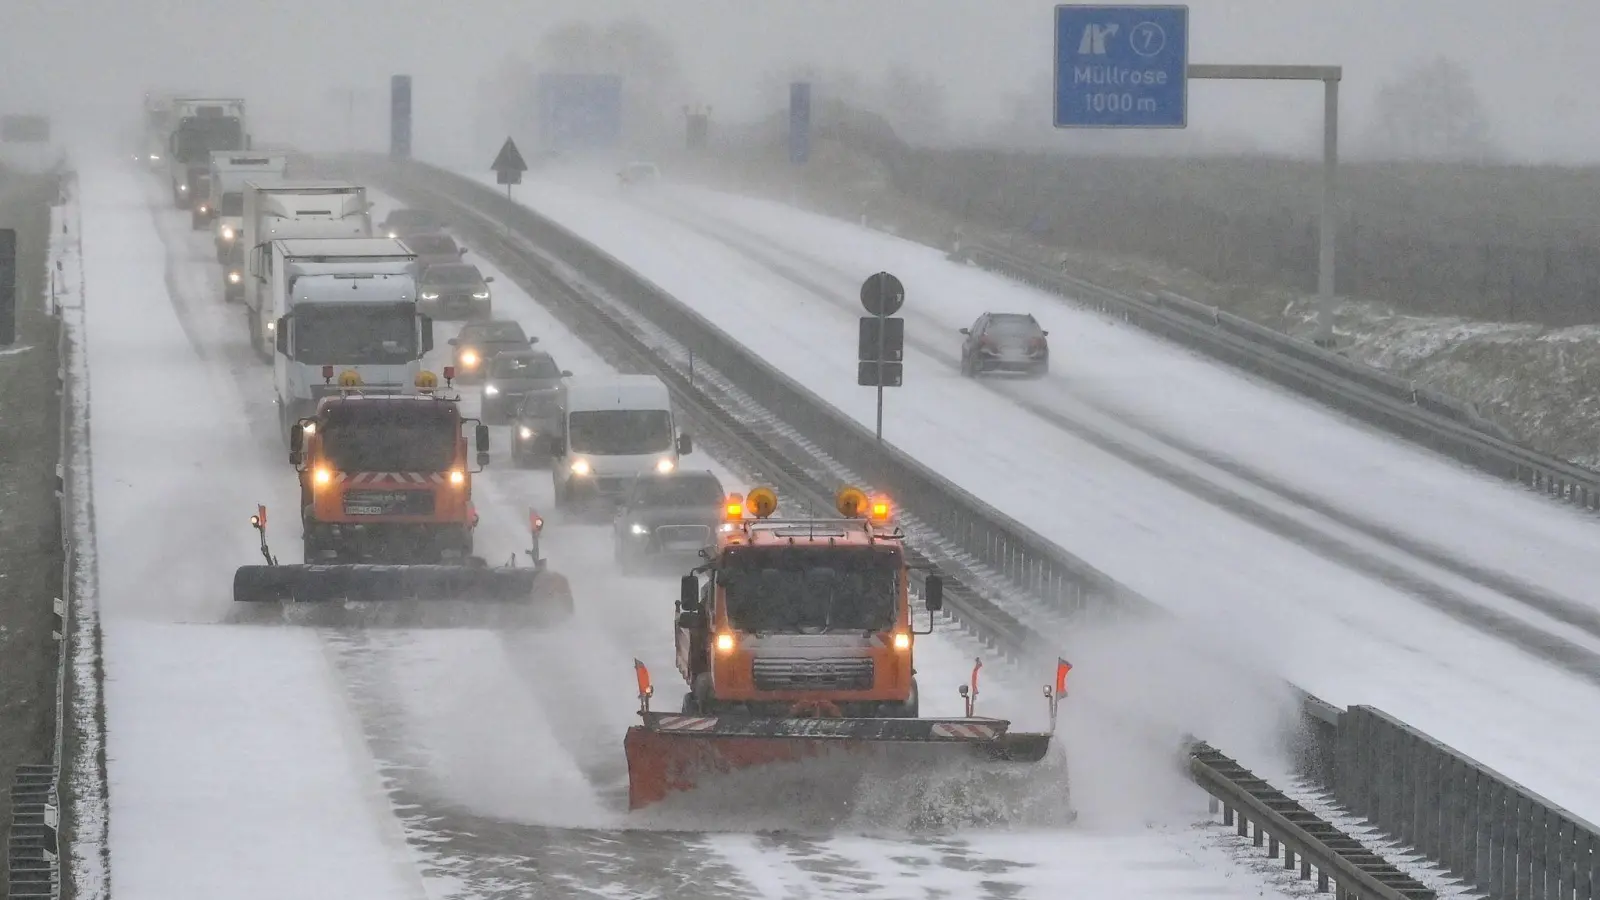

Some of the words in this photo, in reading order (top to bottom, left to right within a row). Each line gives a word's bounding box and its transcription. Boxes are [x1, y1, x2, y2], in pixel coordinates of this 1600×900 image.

[1142, 28, 1153, 49] 7
[1074, 65, 1168, 84] Müllrose
[1086, 93, 1133, 112] 1000
[1137, 97, 1157, 112] m
